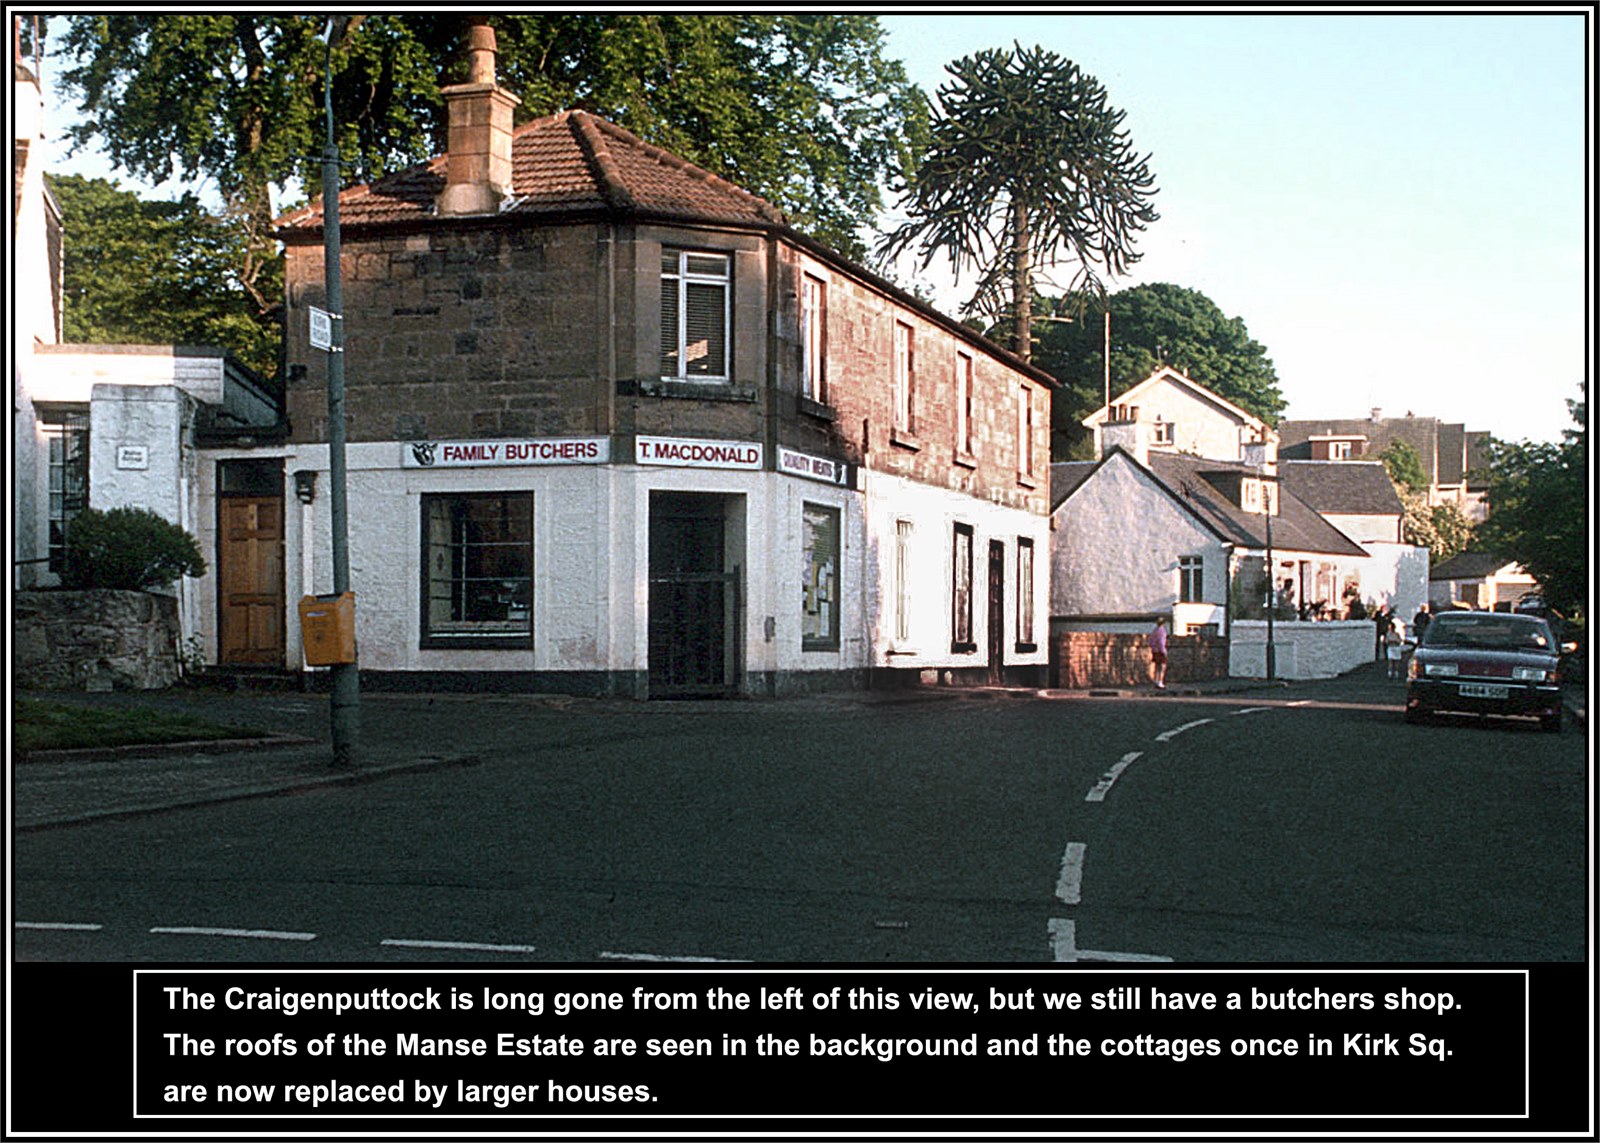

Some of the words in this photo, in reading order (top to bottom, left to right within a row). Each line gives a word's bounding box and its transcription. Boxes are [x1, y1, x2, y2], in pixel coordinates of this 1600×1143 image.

[443, 445, 499, 461] FAMILY
[505, 442, 599, 460] BUTCHERS
[639, 442, 651, 458] T.
[654, 443, 759, 464] MACDONALD
[783, 452, 809, 472] QUALITY
[812, 459, 832, 478] MEATS
